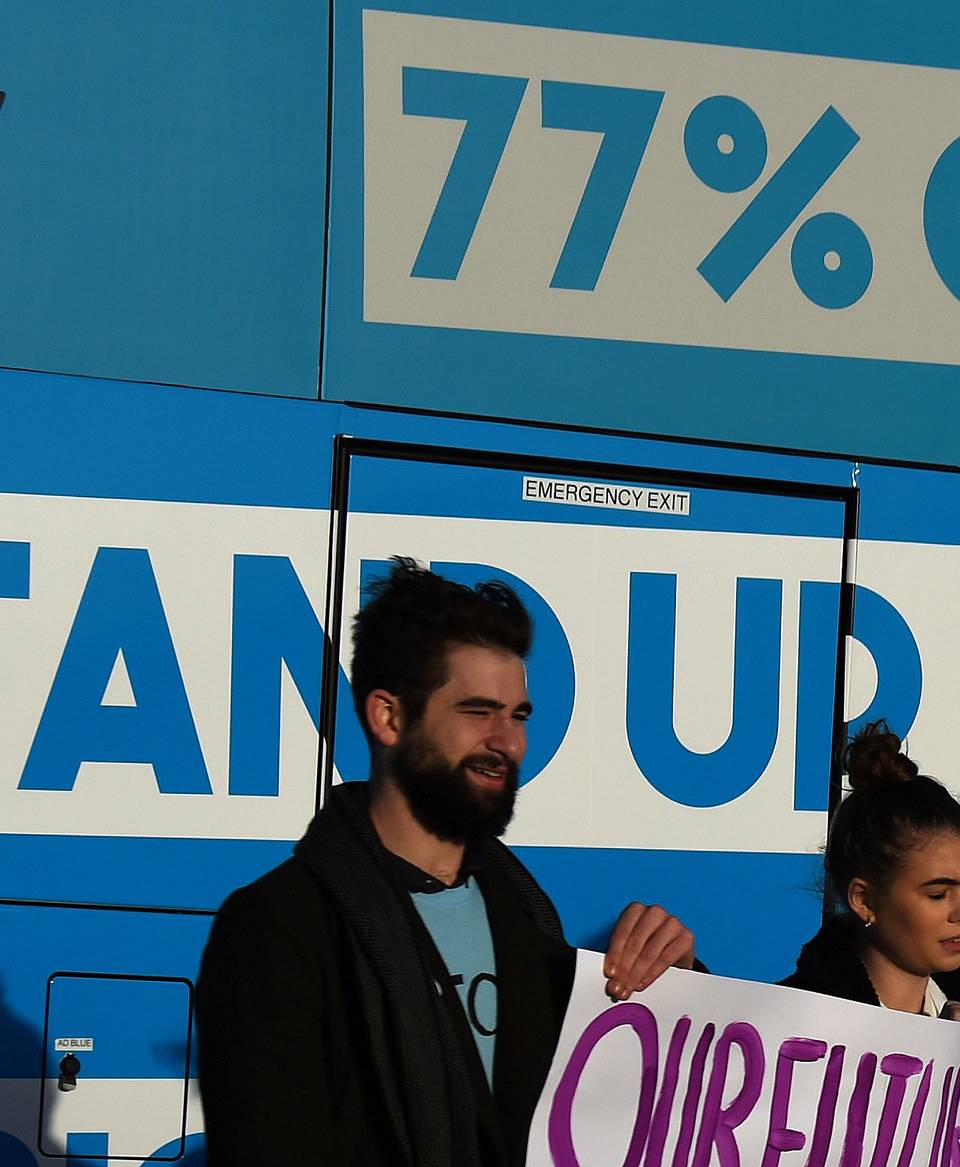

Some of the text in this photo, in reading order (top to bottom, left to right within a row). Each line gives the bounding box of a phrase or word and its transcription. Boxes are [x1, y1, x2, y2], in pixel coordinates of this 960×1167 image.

[402, 66, 873, 310] 77%
[525, 480, 688, 511] EMERGENCY EXIT
[0, 541, 576, 797] AND
[625, 571, 923, 811] UP
